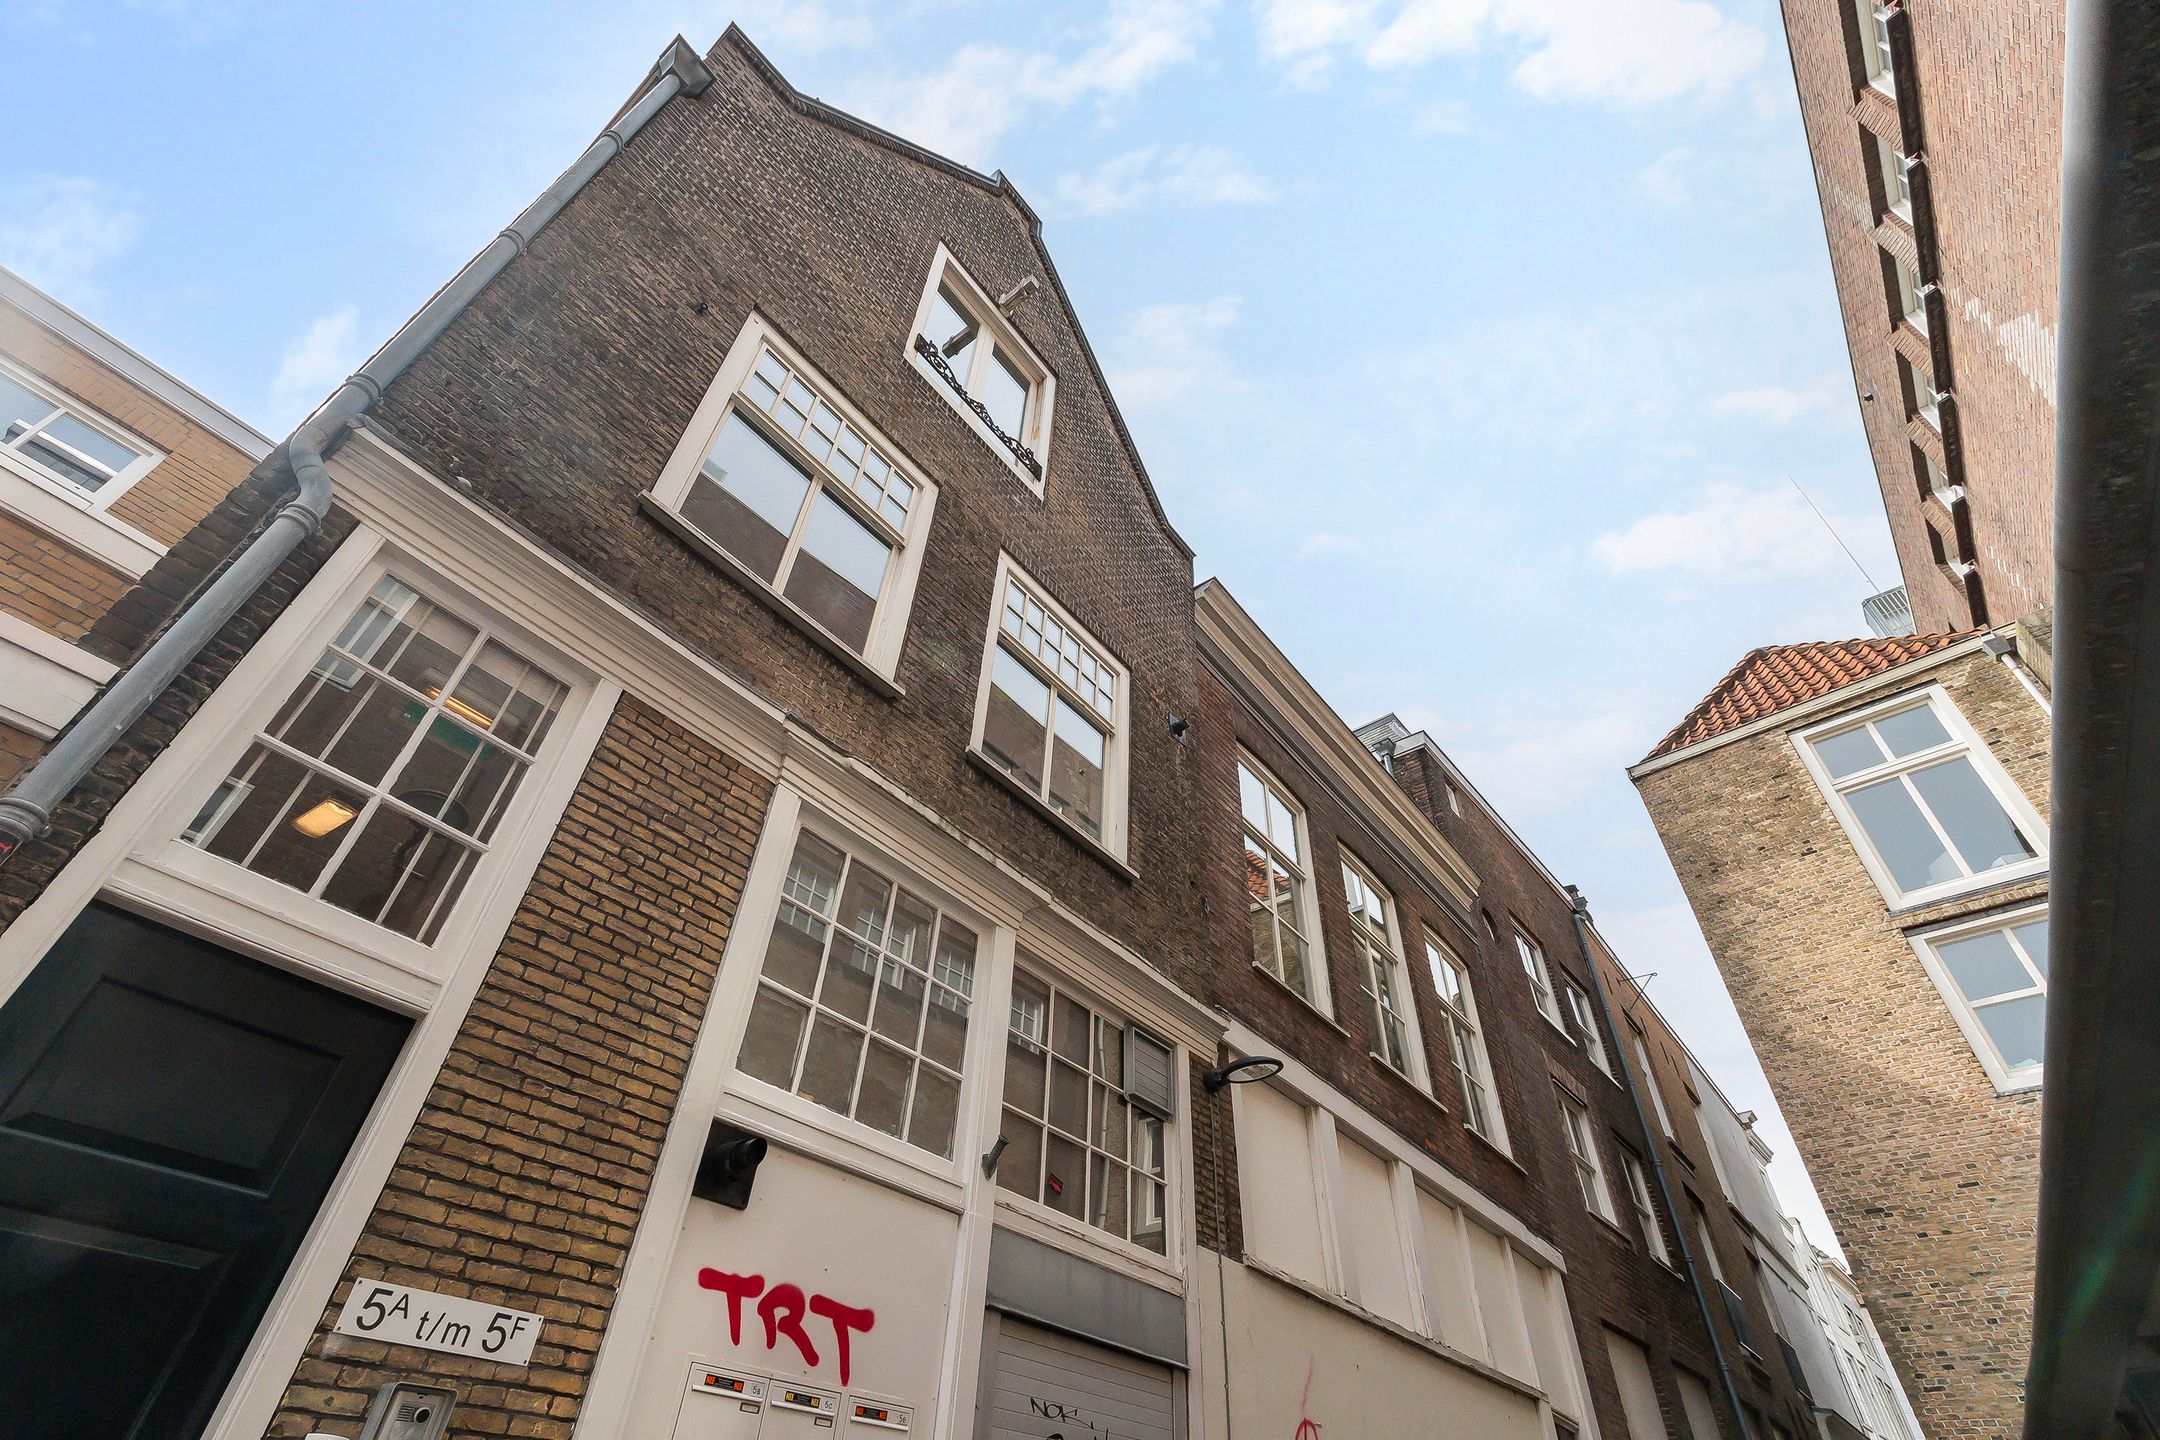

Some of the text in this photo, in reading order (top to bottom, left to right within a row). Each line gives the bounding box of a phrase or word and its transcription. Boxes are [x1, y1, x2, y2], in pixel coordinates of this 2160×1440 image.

[356, 1287, 530, 1353] 5A t/m 5F
[698, 1267, 876, 1387] TRT
